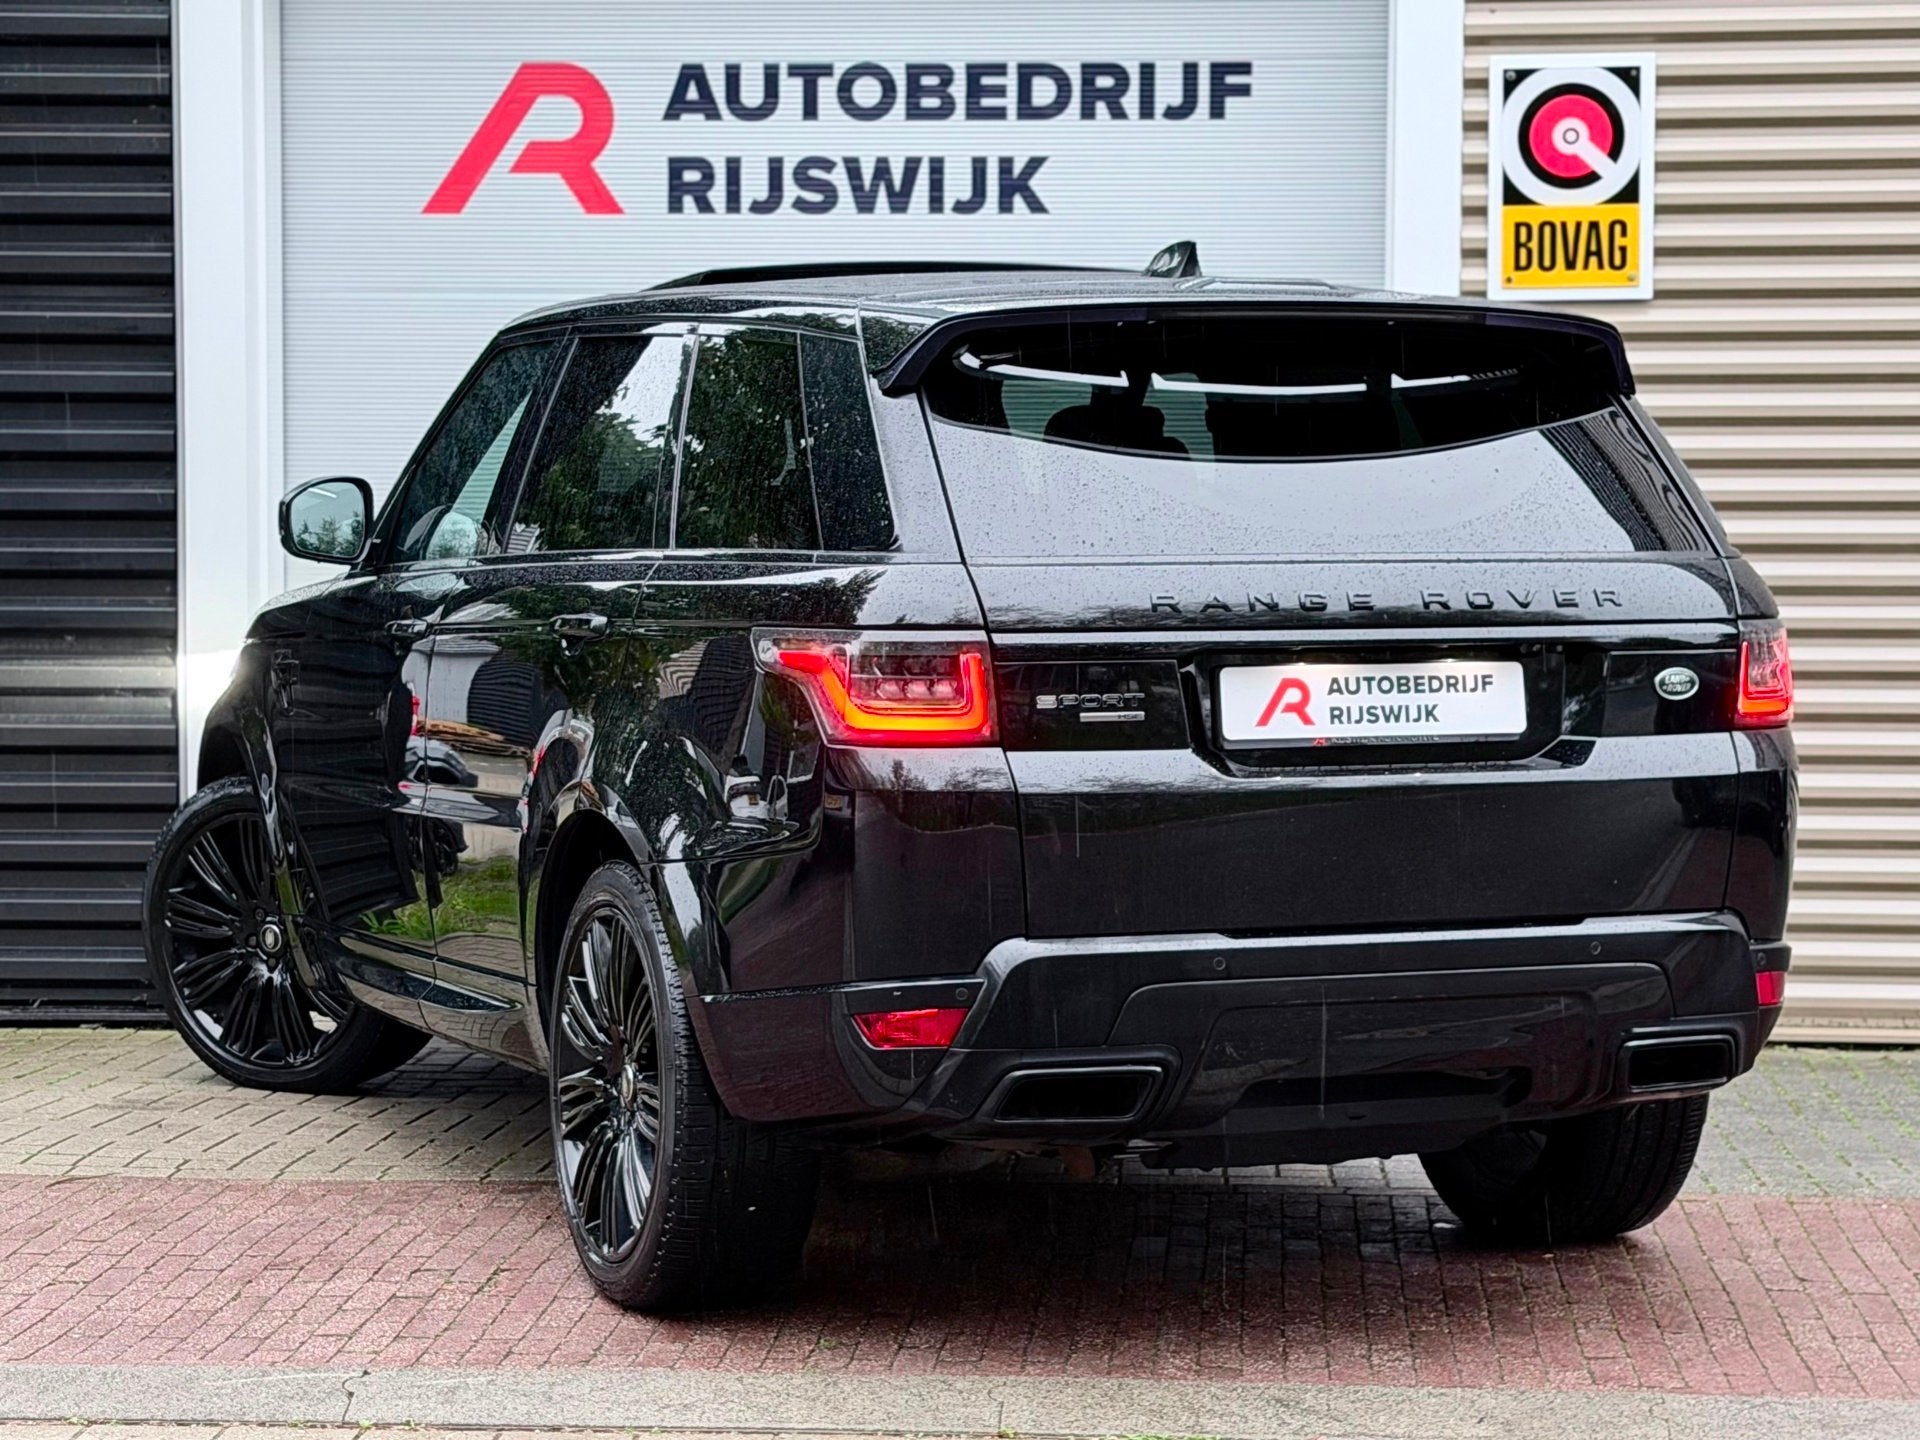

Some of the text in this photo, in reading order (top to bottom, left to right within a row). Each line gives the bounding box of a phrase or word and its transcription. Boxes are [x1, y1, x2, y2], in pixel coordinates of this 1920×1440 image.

[663, 61, 1253, 121] AUTOBEDRIJF
[666, 156, 1051, 215] RIJSWIJK
[1513, 219, 1628, 272] BOVAG
[1149, 588, 1623, 614] RANGE ROVER
[1327, 674, 1495, 696] AUTOBEDRIJF
[1035, 692, 1146, 709] SPORT
[1329, 703, 1441, 726] RIJSWIJK
